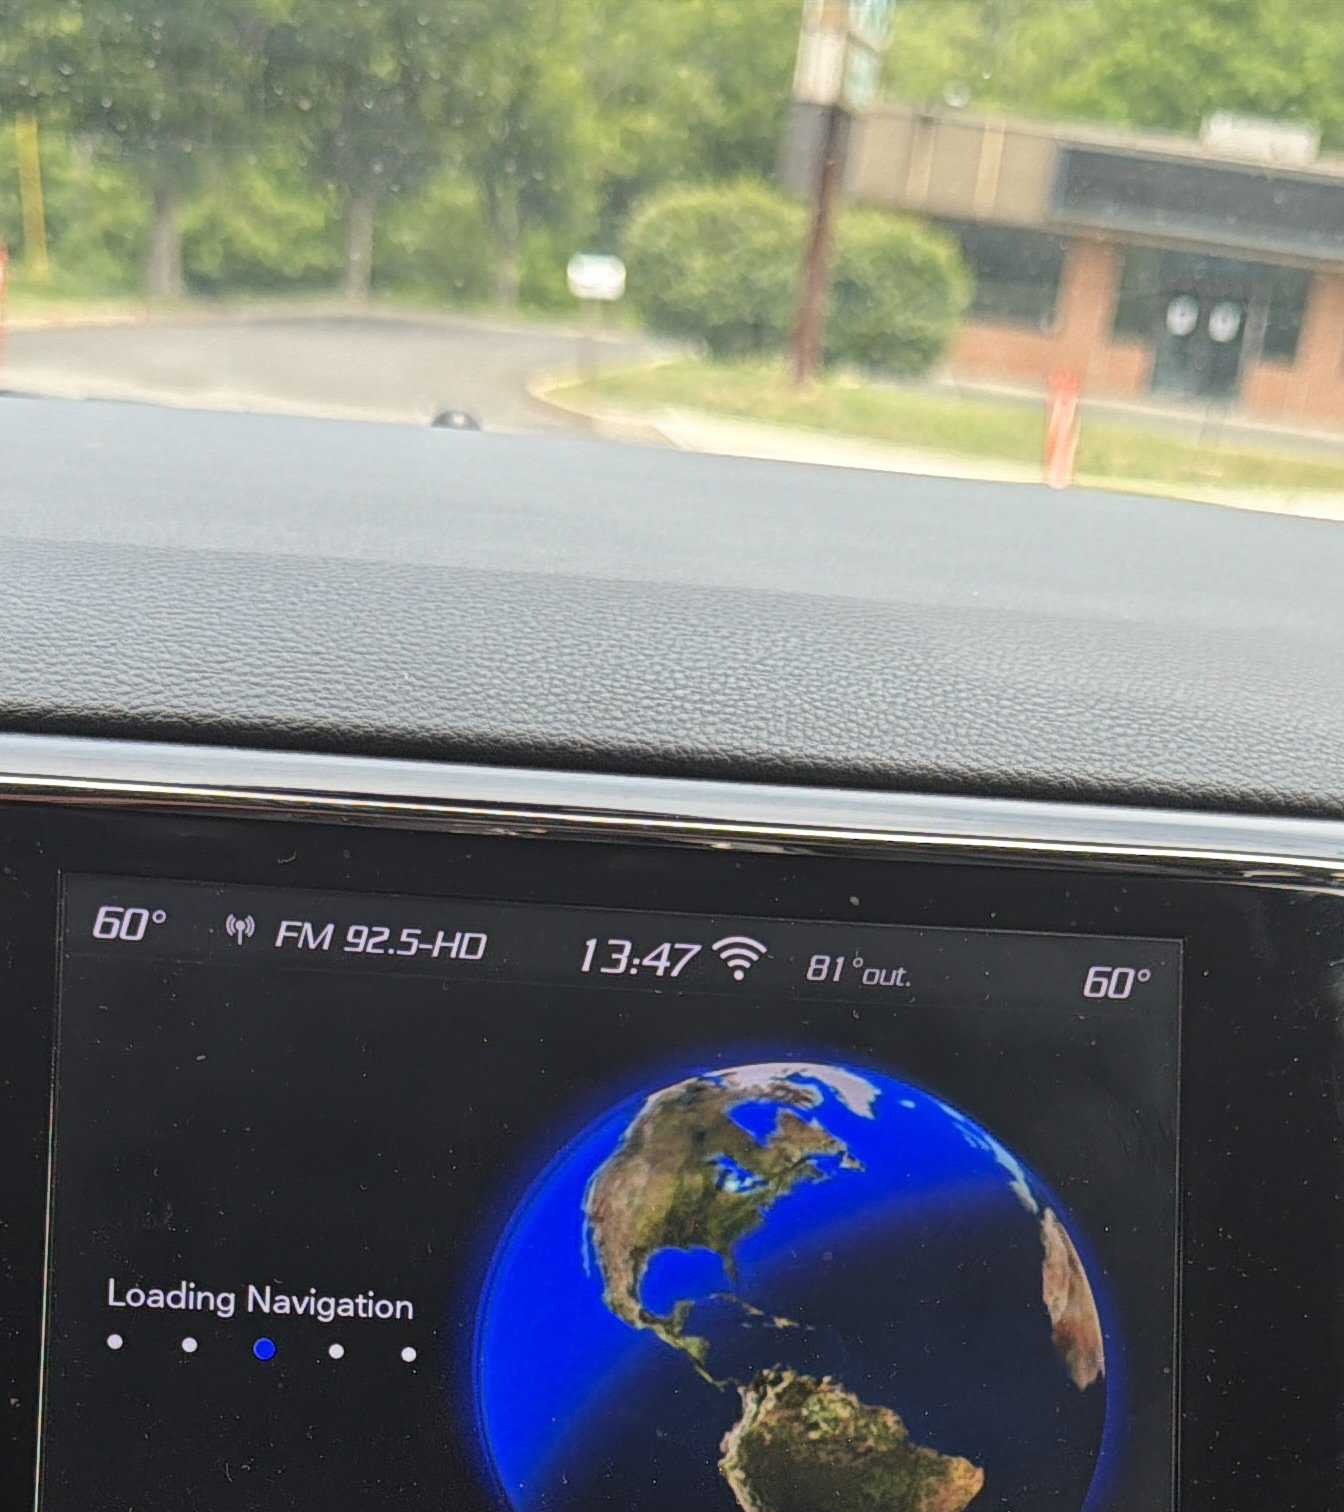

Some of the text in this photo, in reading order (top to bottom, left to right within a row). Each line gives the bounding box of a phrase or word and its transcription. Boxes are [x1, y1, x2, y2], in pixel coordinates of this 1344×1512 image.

[92, 905, 167, 941] 60°
[274, 920, 488, 960] FM 92.5-HD
[581, 938, 703, 977] 13:47
[1083, 966, 1151, 999] 60°
[108, 1277, 414, 1323] Loading Navigation
